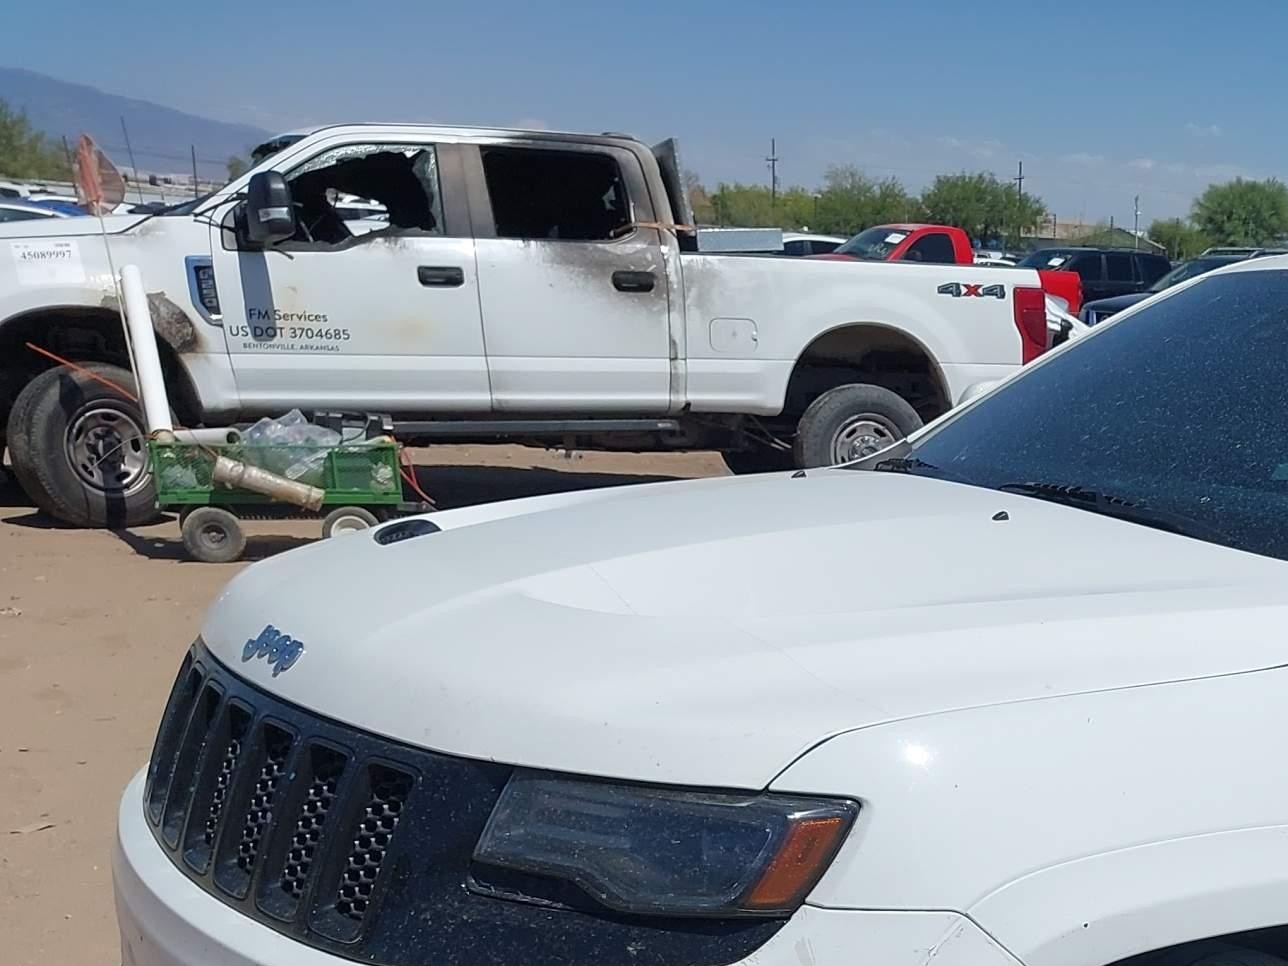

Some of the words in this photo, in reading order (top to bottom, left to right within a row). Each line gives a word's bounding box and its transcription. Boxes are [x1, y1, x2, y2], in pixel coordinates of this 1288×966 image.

[21, 249, 71, 260] 45089997
[248, 308, 271, 320] FM
[274, 309, 328, 322] Services
[229, 325, 249, 337] US
[254, 326, 285, 339] DOT
[289, 328, 351, 340] 3704685
[300, 344, 340, 352] ARKANSAS
[241, 624, 305, 678] Jeep
